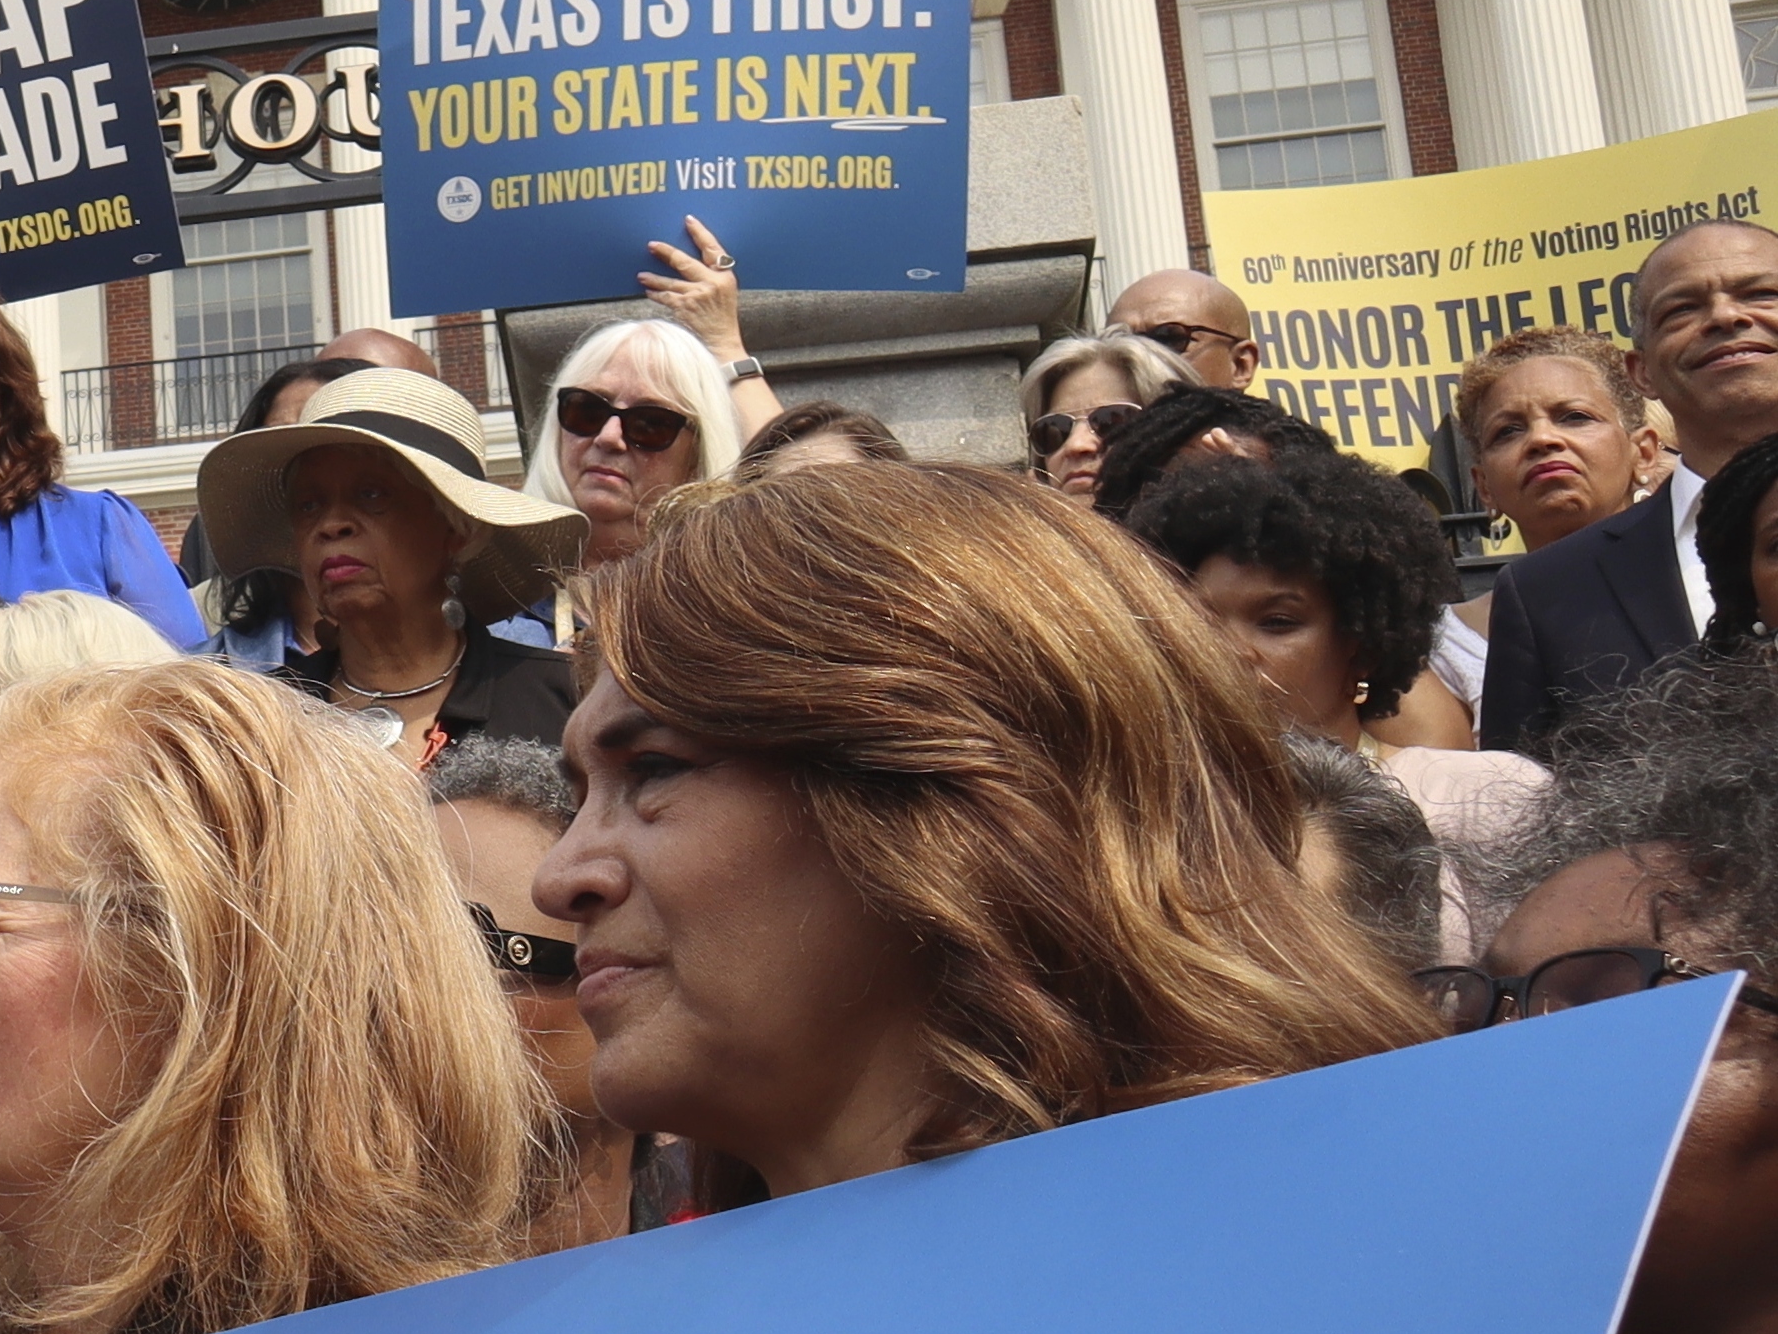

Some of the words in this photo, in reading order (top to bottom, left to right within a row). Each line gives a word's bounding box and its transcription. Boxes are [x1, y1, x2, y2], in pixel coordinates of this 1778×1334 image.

[408, 73, 539, 152] YOUR
[552, 58, 700, 133] STATE
[716, 55, 769, 121] IS
[786, 51, 932, 118] NEXT.
[491, 176, 534, 211] GET
[536, 161, 667, 207] INVOLVED!
[676, 155, 737, 193] Visit
[744, 154, 900, 191] TXSDC.ORG.
[1243, 253, 1287, 284] 60th
[1294, 248, 1440, 283] Anniversary
[1449, 239, 1475, 271] of
[1482, 237, 1523, 267] the
[1530, 220, 1619, 259] Voting
[1624, 199, 1712, 244] Rights
[1716, 185, 1761, 220] Act
[1250, 304, 1431, 371] HONOR
[1434, 290, 1535, 364] THE
